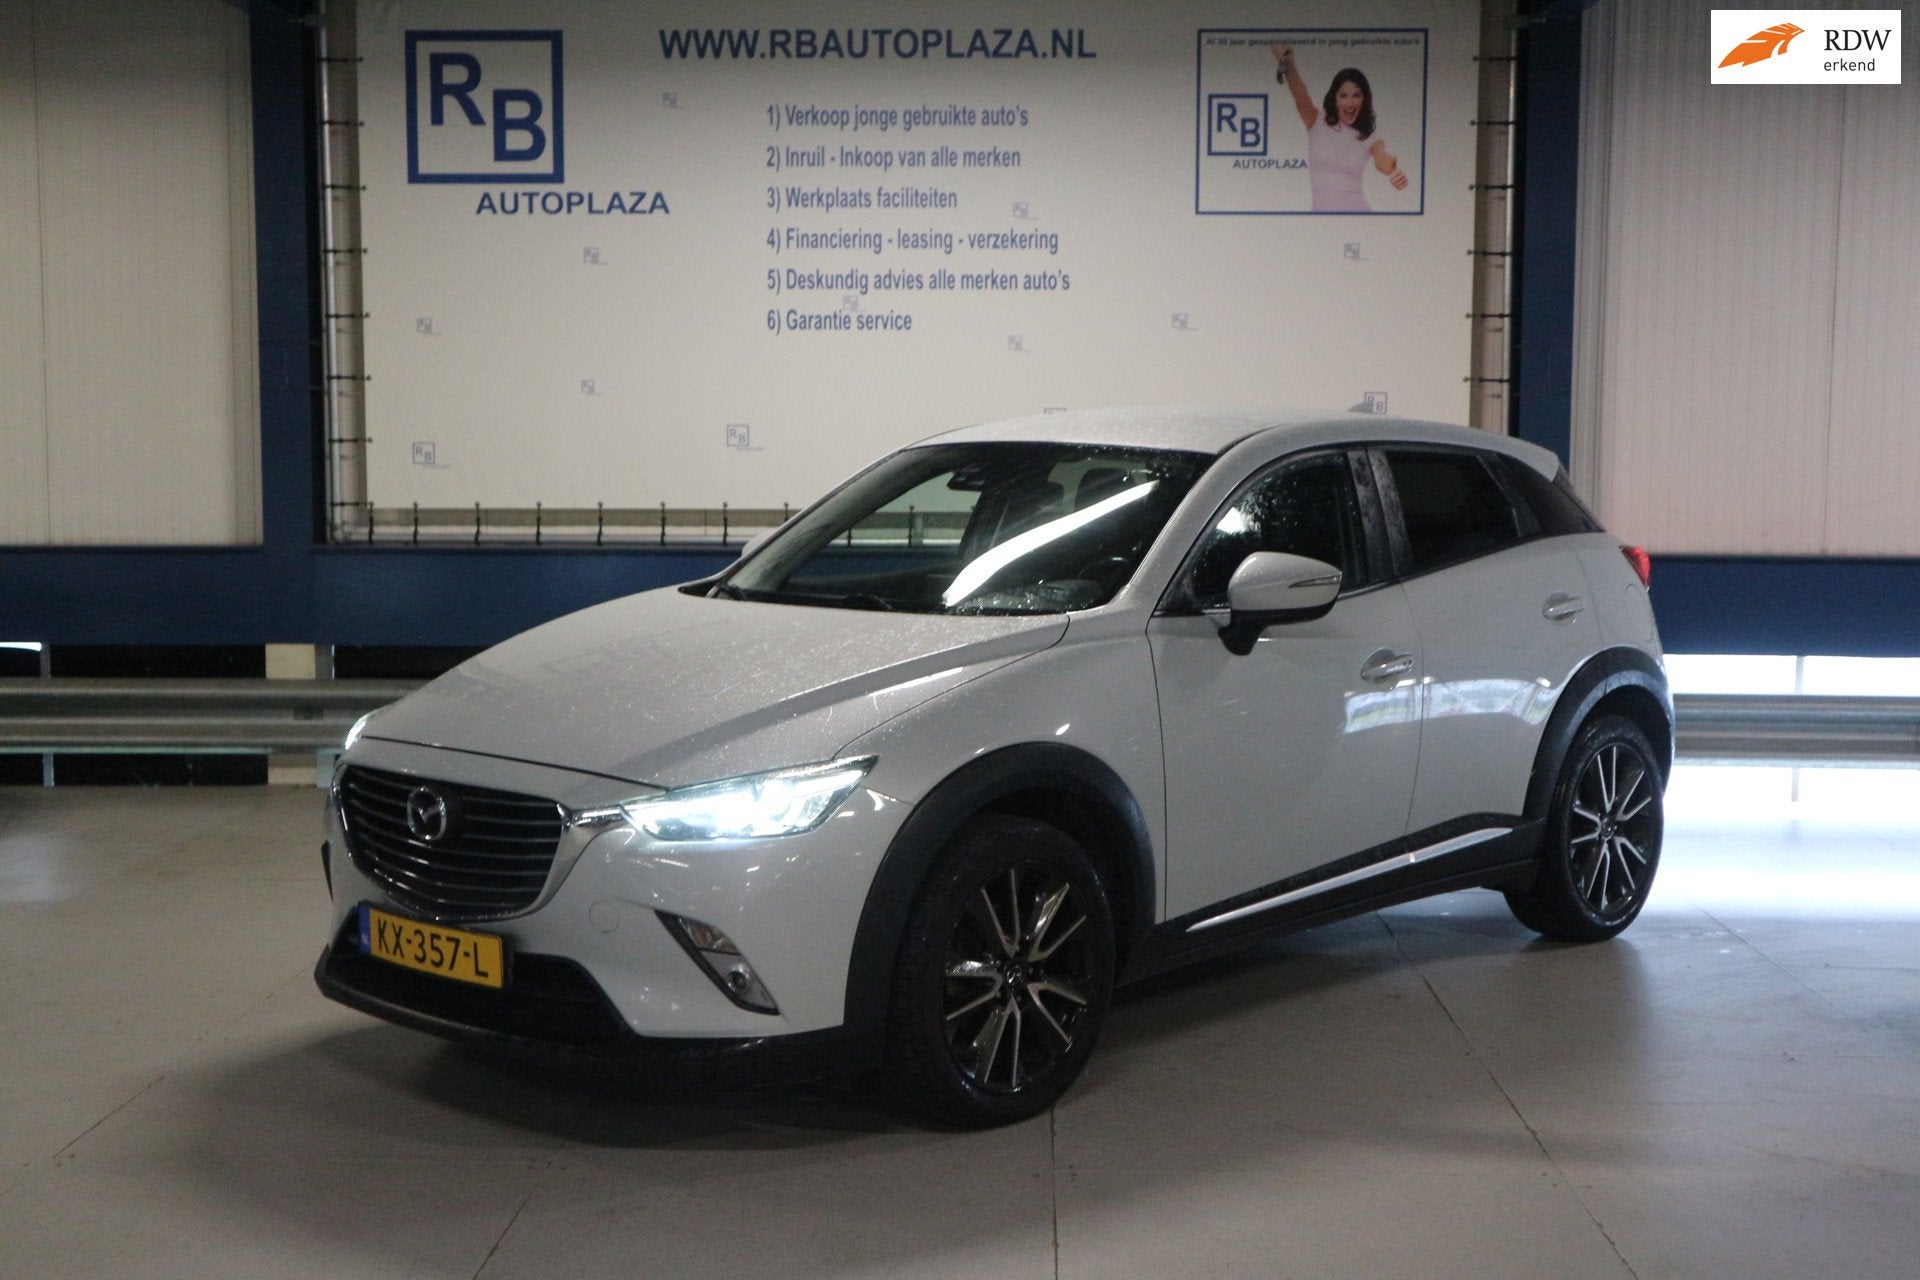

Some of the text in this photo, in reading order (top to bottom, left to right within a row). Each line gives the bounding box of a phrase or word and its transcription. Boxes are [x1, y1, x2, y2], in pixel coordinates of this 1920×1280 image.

[659, 29, 1097, 59] WWW.RBAUTOPLAZA.NL
[430, 53, 547, 163] RB
[767, 106, 1029, 131] 1) Verkoop jonge gebruikte auto's
[1216, 102, 1261, 148] RB
[767, 146, 781, 171] 2)
[786, 146, 825, 167] Inruil
[840, 146, 893, 171] Inkoop
[899, 151, 926, 167] van
[931, 146, 957, 167] alle
[963, 146, 1020, 167] merken
[1233, 158, 1308, 170] AUTOPLAZA
[475, 191, 670, 215] AUTOPLAZA
[767, 187, 958, 213] 3) Werkplaats faciliteiten
[767, 228, 781, 254] 4)
[786, 228, 882, 254] Financiering
[898, 228, 953, 255] leasing
[968, 228, 1058, 255] verzekering
[767, 268, 1071, 295] 5) Deskundig advies alle merken auto's
[767, 309, 912, 335] 6) Garantie service
[377, 917, 489, 978] KX-357-L
